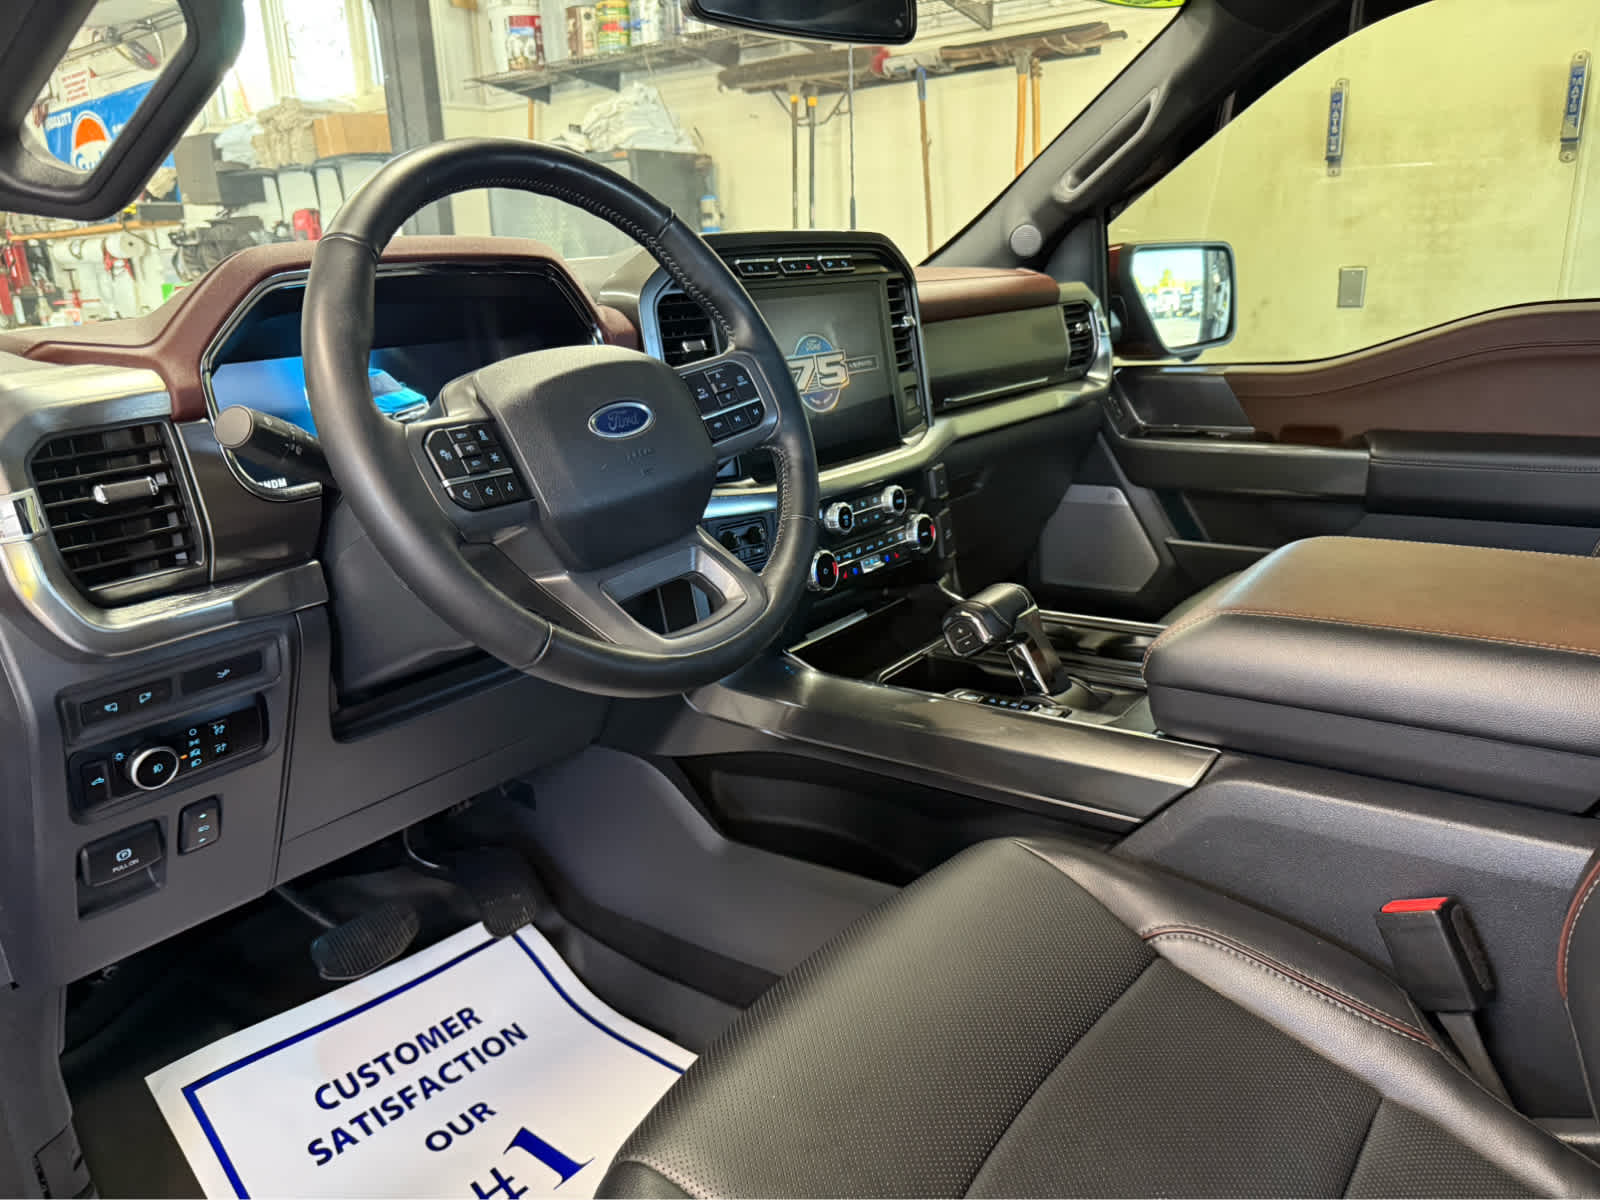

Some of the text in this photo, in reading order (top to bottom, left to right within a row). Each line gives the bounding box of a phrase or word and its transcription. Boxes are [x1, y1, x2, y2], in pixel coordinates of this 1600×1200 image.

[786, 352, 848, 391] 75
[607, 409, 640, 431] Ford
[314, 1007, 482, 1110] CUSTOMER
[307, 1023, 528, 1166] SATISFACTION
[425, 1102, 497, 1152] OUR
